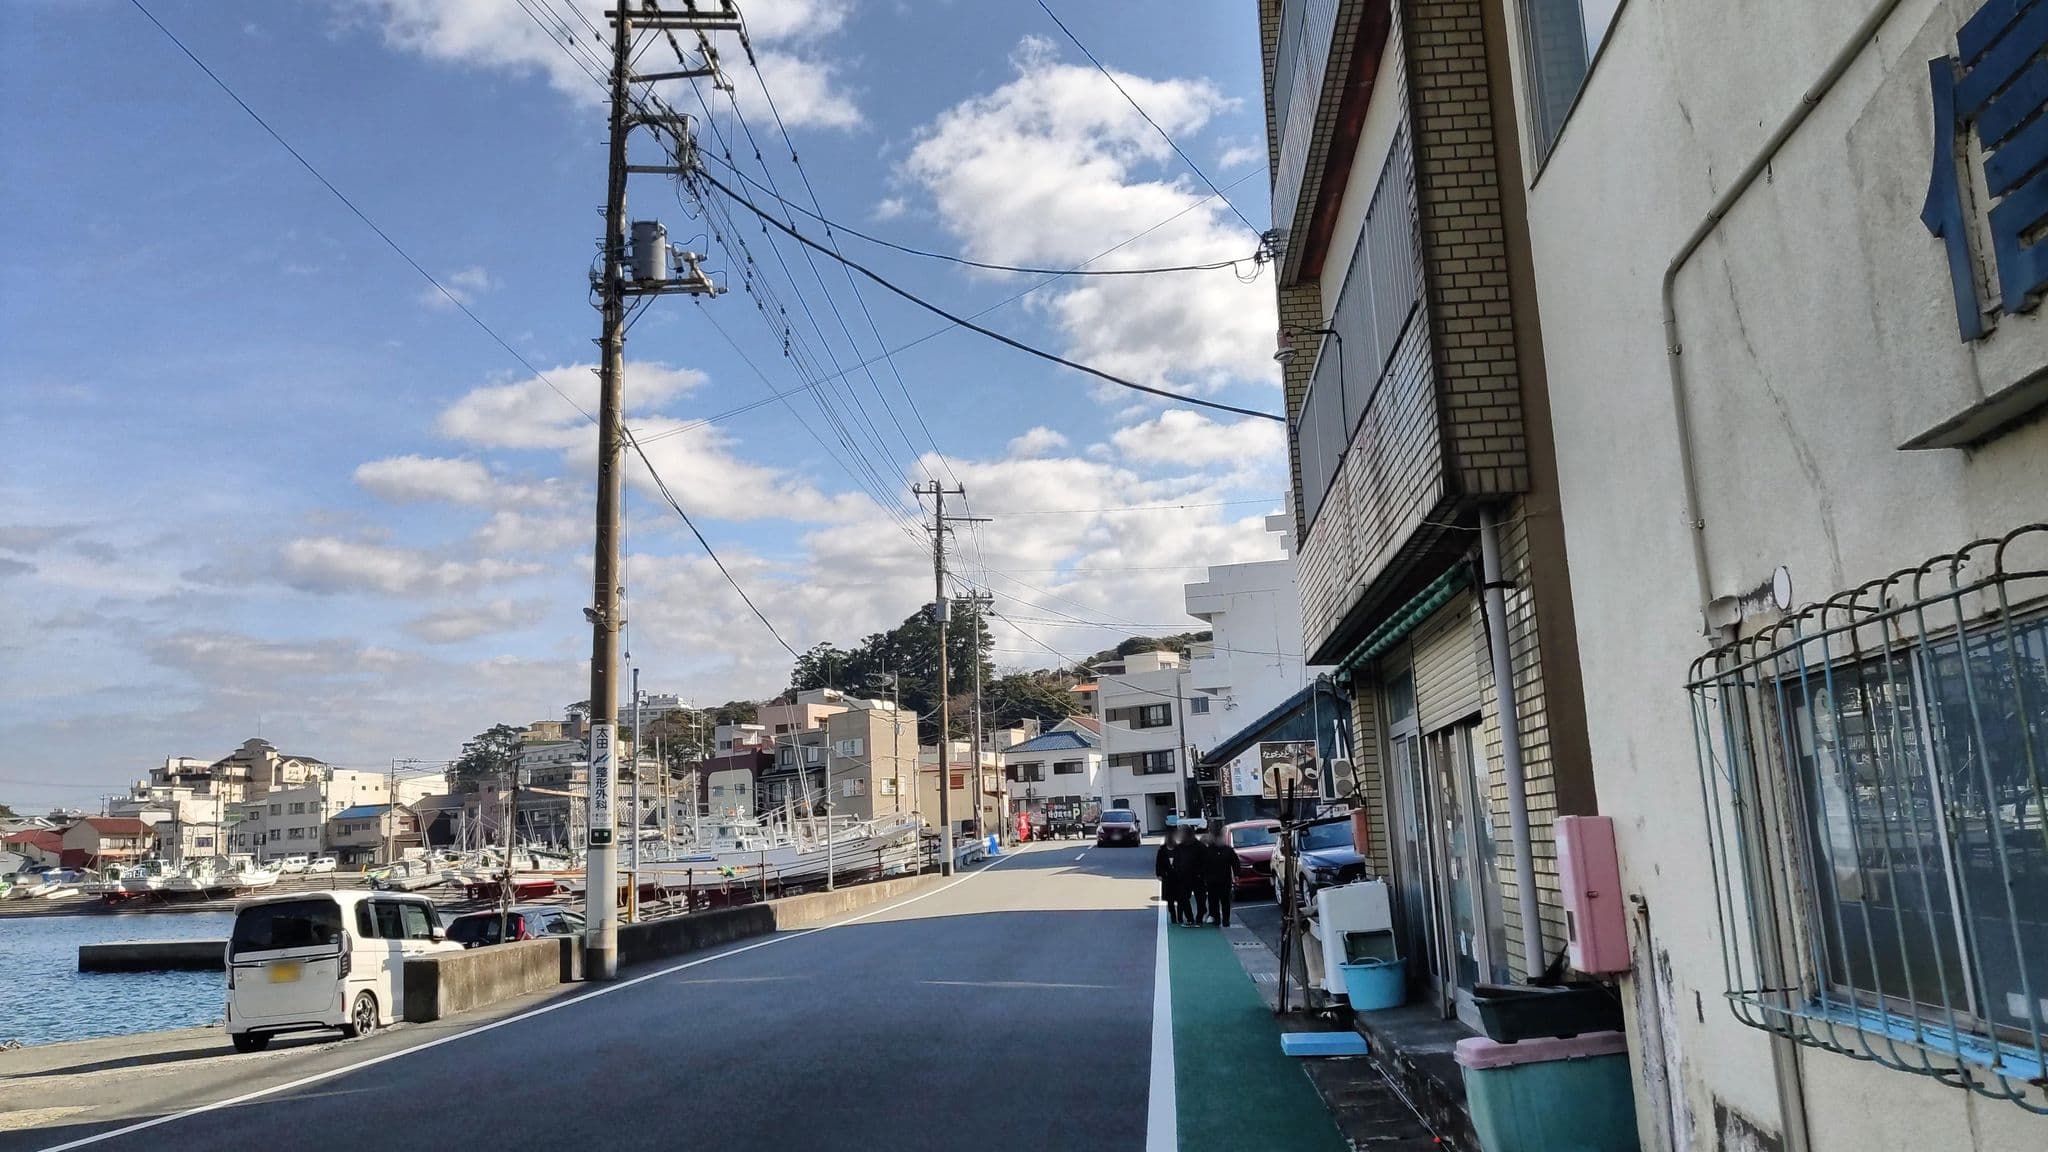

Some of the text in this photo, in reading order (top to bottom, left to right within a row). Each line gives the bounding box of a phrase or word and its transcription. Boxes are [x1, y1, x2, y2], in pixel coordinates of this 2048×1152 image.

[596, 727, 609, 749] 太田
[595, 766, 609, 811] 整形外科
[1073, 808, 1081, 819] P
